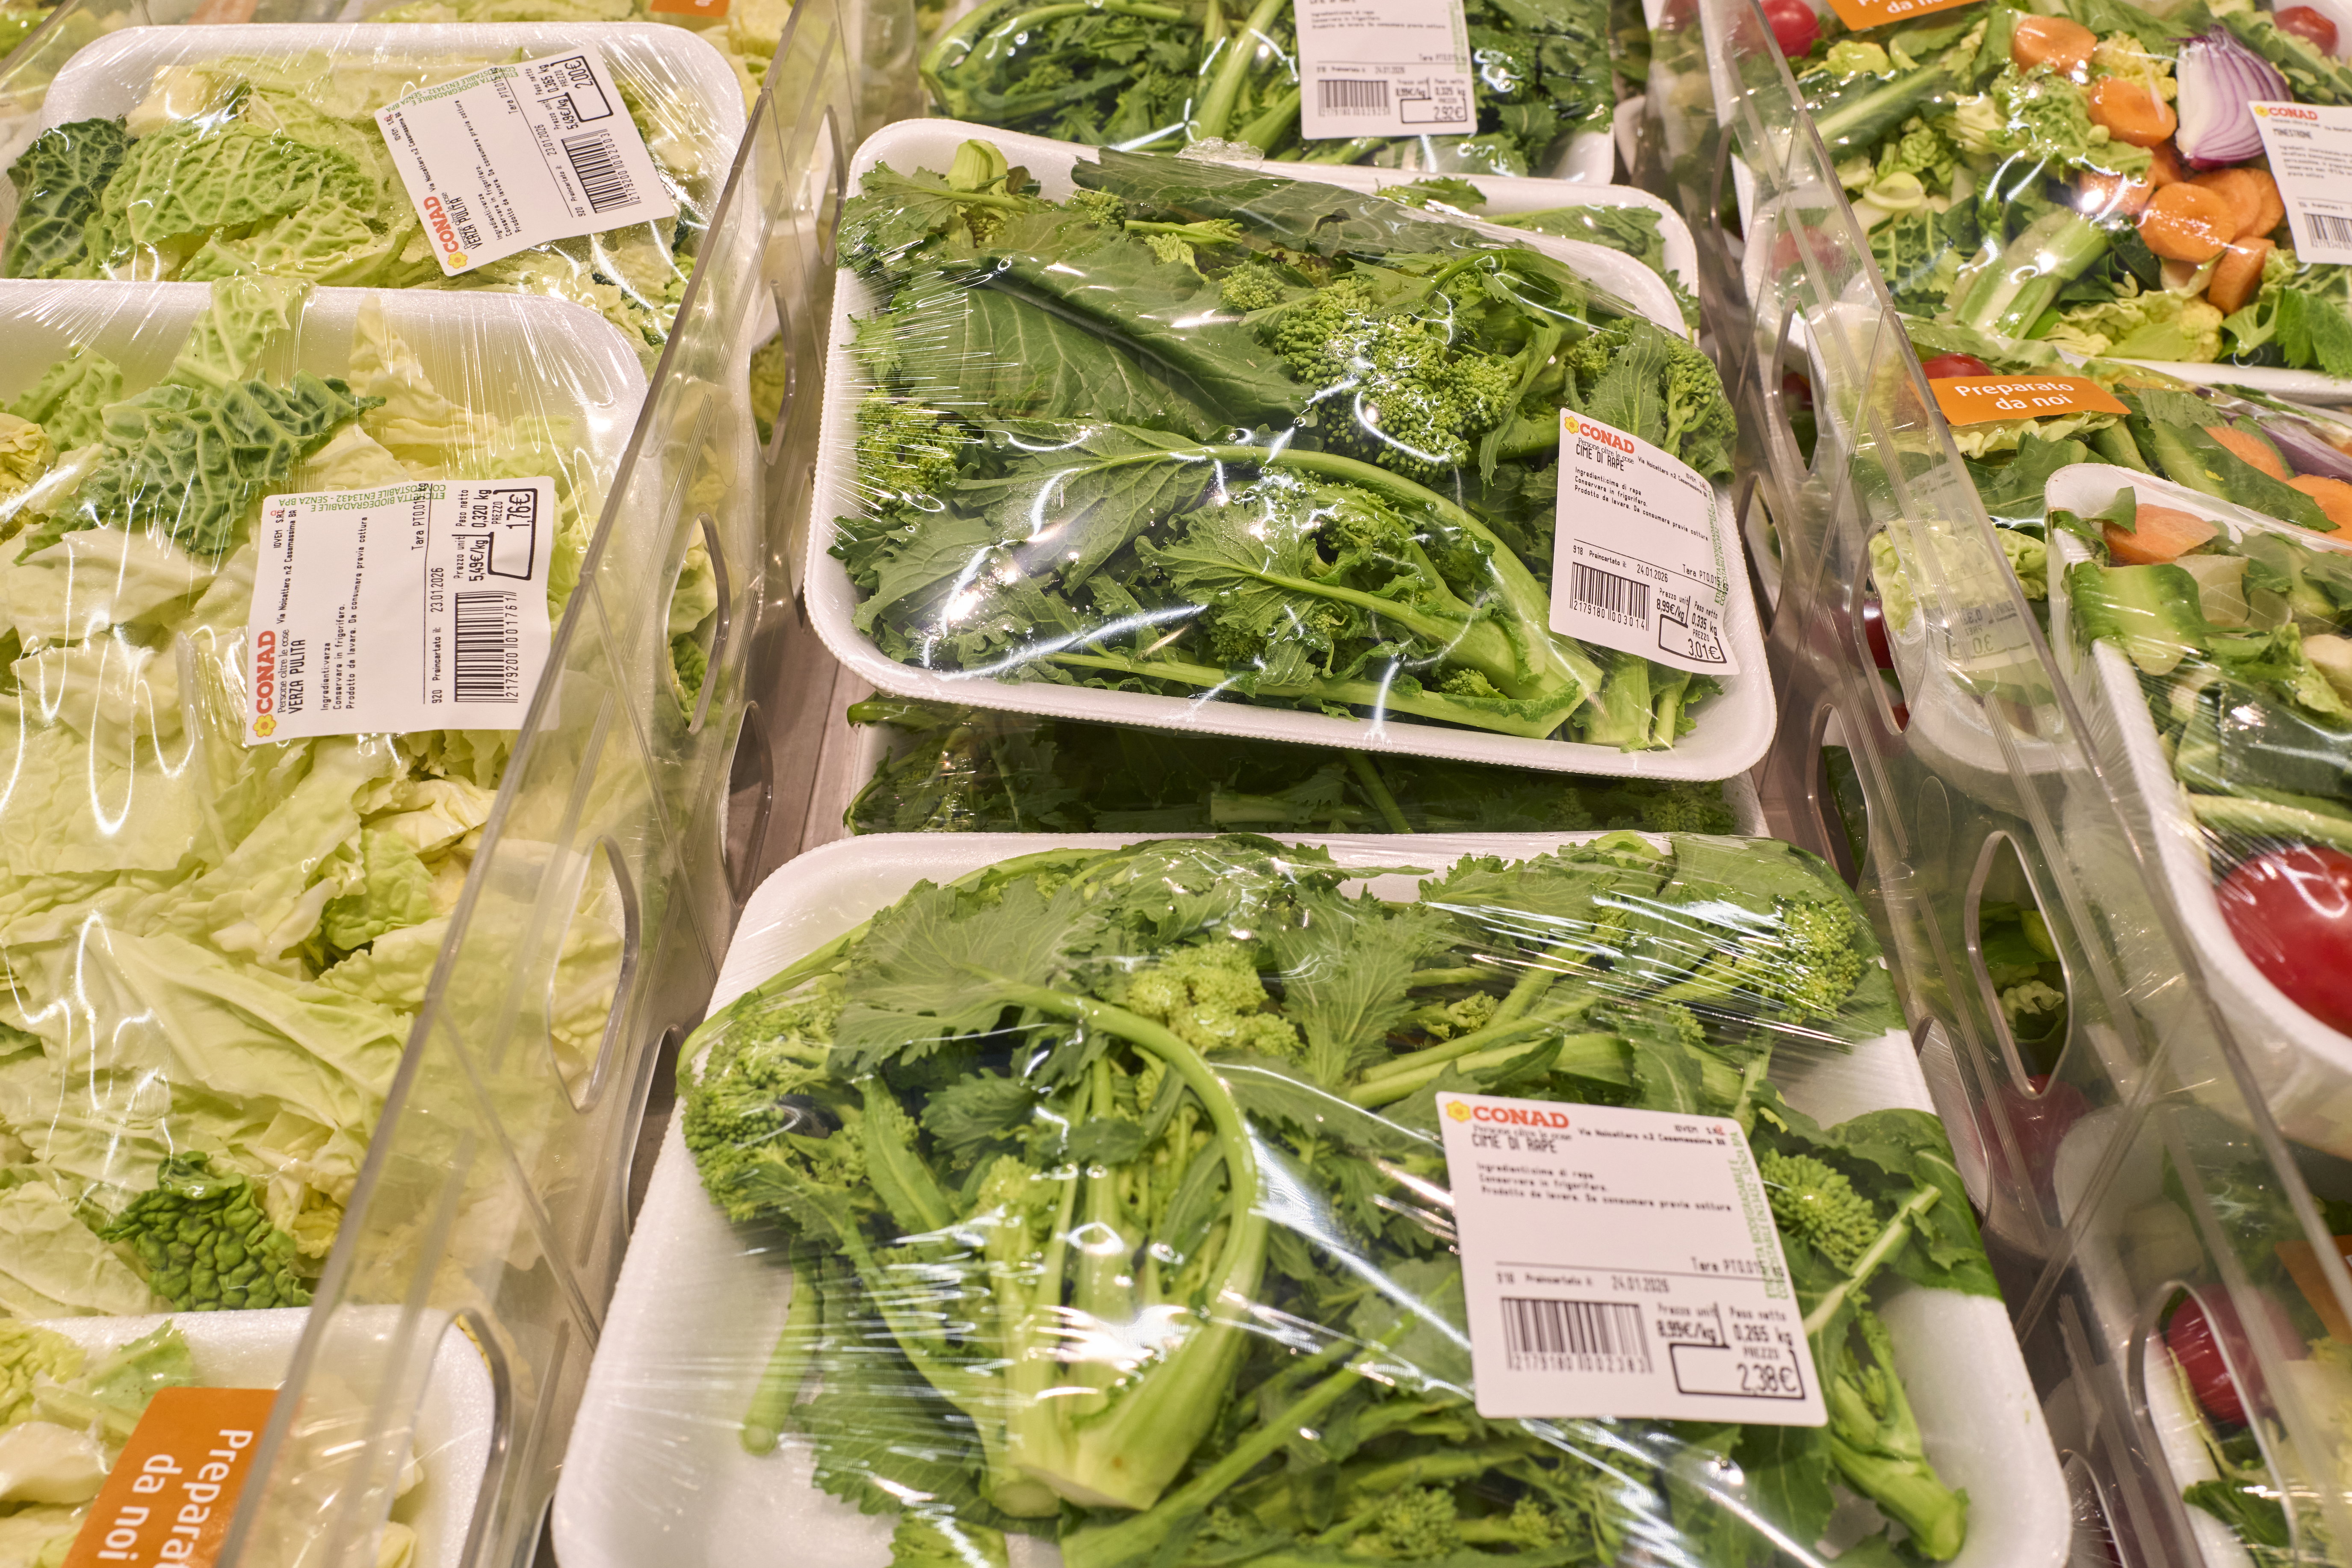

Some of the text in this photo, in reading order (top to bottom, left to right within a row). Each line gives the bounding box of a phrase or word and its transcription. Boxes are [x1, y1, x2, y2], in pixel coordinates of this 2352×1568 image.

[524, 68, 544, 95] Peso netto
[538, 64, 559, 93] 0,365 kg
[554, 69, 569, 87] PREZZO
[564, 57, 596, 89] 2,00€
[454, 100, 467, 118] cottura
[506, 100, 518, 114] Tara
[556, 97, 579, 130] 5,49€/kg
[2269, 107, 2318, 120] CONAD
[399, 118, 415, 147] Casamassima
[464, 121, 478, 136] previa
[549, 112, 561, 130] Prezzo
[473, 138, 490, 166] consumare
[534, 124, 557, 156] 23.01.2026
[416, 156, 432, 182] Noicattaro
[476, 164, 493, 195] frigorifero.
[493, 177, 505, 197] lavare.
[559, 171, 586, 217] 920 Preincartato
[423, 196, 459, 253] CONAD
[441, 192, 471, 250] Persone oltre le cose
[449, 197, 483, 249] VERZA PULITA
[494, 204, 512, 236] Conservare
[506, 207, 522, 233] Prodotto
[1954, 382, 2074, 396] Preparato
[1995, 394, 2073, 410] da noi
[1578, 437, 1634, 464] Persone oltre le cose
[1579, 422, 1634, 454] CONAD
[1576, 443, 1624, 471] CIME DI RAPE
[1646, 460, 1668, 475] Noicattaro
[278, 497, 297, 506] BPA
[298, 496, 328, 505] SENZA
[318, 496, 395, 511] BIODEGRADABILE
[336, 492, 375, 502] EN13432
[1575, 475, 1606, 492] Conservare
[1617, 490, 1647, 507] frigorifero.
[1629, 487, 1641, 496] rape
[455, 490, 468, 526] Peso netto
[471, 489, 492, 528] 0,320 kg
[491, 501, 503, 524] PREZZO
[505, 493, 532, 529] 1,76€
[1575, 484, 1599, 499] Prodotto
[1611, 497, 1630, 509] lavare.
[1634, 505, 1640, 513] Da
[1643, 510, 1669, 525] consumare
[1672, 522, 1688, 532] previa
[1690, 529, 1708, 541] cottura
[273, 529, 283, 548] IOVEM
[284, 520, 296, 562] Casamassima
[411, 530, 424, 550] Tara
[453, 554, 464, 579] Prezzo
[468, 540, 489, 582] 5,49€/kg
[1573, 545, 1620, 566] 918 Preincartato
[283, 565, 292, 575] n.2
[1637, 564, 1668, 582] 24.01.2026
[1682, 563, 1696, 577] Tara
[278, 578, 291, 611] Noicattaro
[430, 567, 444, 612] 23.01.2026
[1659, 587, 1676, 600] Prezzo
[276, 613, 286, 624] Via
[345, 517, 367, 709] Prodotto da lavare. Da consumare previa cottura
[1656, 598, 1684, 622] 8,99€/kg
[1694, 600, 1717, 619] Peso netto
[334, 604, 346, 647] frigorifero.
[1691, 612, 1717, 636] 0,335 kg
[1692, 628, 1709, 642] PREZZO
[278, 649, 288, 657] le
[431, 636, 441, 681] Preincartato
[502, 595, 518, 697] 2179200 001761
[1687, 638, 1720, 663] 3,01€
[255, 630, 275, 714] CONAD
[278, 659, 287, 678] oltre
[288, 639, 305, 714] VERZA PULITA
[277, 680, 287, 713] Persone
[332, 663, 343, 709] Conservare
[431, 689, 442, 703] 920
[1472, 1104, 1570, 1129] CONAD
[98, 1454, 183, 1560] da noi
[153, 1429, 253, 1568] Prepara
